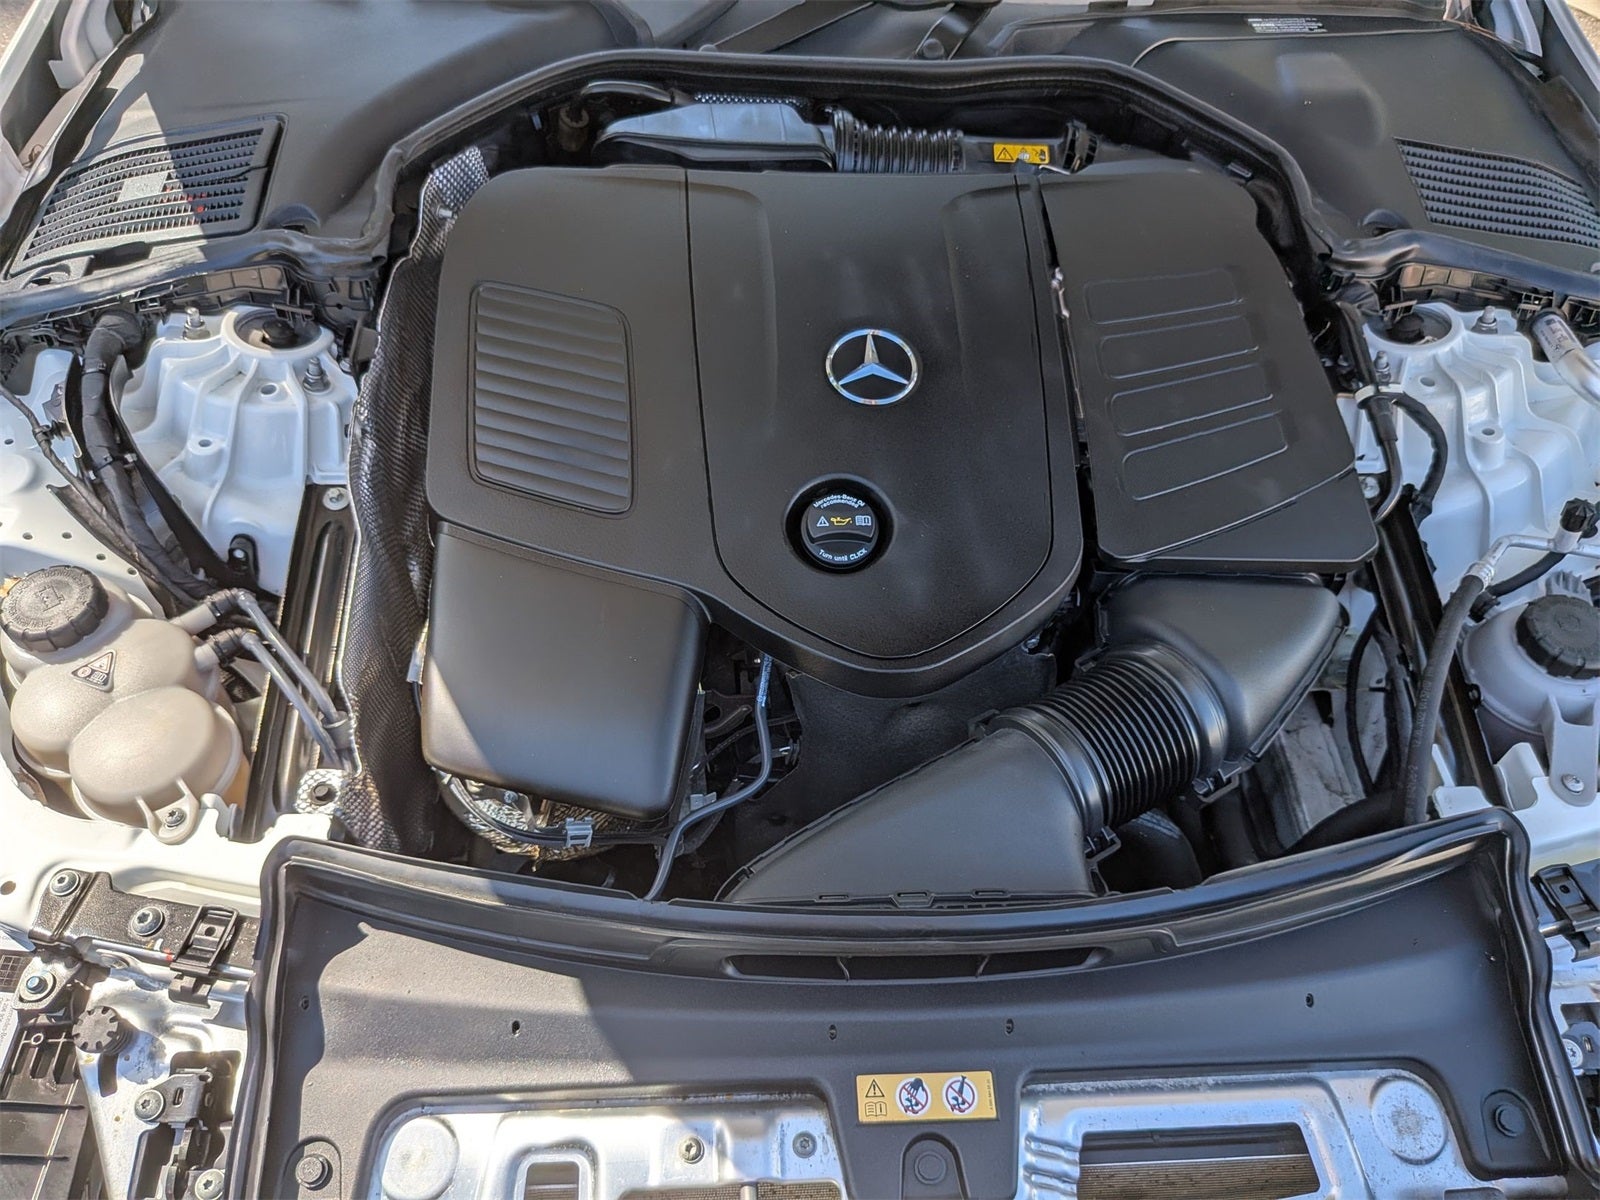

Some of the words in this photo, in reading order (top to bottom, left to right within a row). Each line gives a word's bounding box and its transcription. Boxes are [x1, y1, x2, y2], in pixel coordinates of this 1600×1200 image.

[813, 494, 857, 507] Mercedes-Benz
[821, 499, 858, 508] recommended
[819, 549, 833, 560] Turn
[850, 548, 867, 560] CLICK
